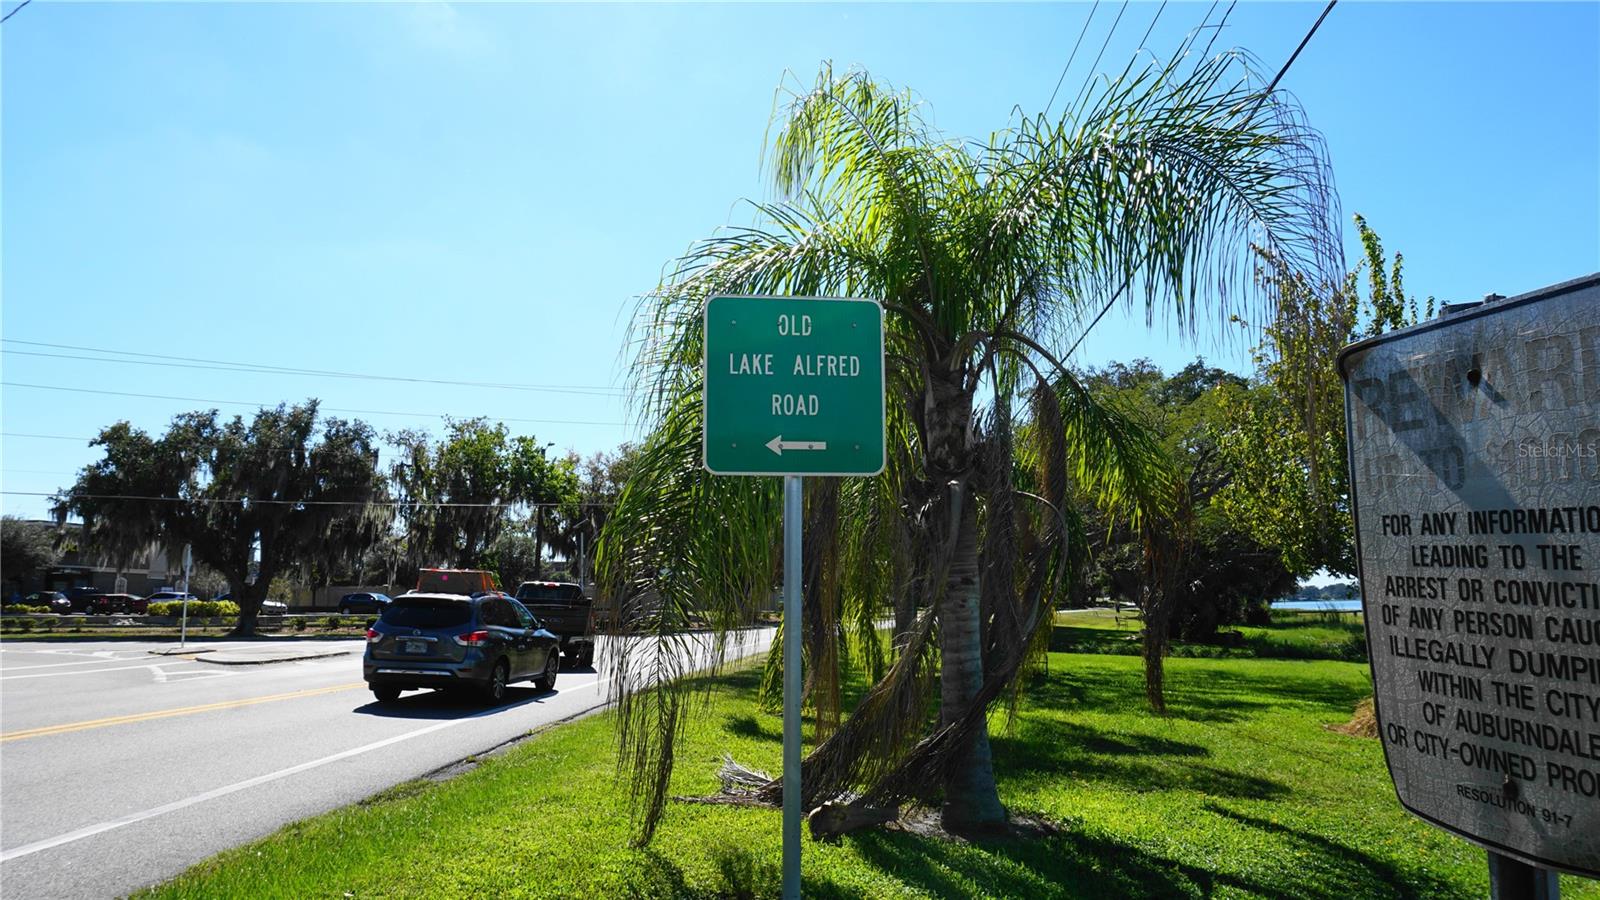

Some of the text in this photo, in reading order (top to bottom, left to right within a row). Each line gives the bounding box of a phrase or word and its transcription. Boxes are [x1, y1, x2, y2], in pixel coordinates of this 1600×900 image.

[778, 314, 812, 336] OLD
[729, 353, 860, 377] LAKE ALFRED
[772, 394, 819, 416] ROAD
[1382, 514, 1412, 537] FOR
[1420, 512, 1457, 536] ANY
[1411, 544, 1583, 571] LEADING TO THE
[1385, 575, 1448, 600] ARREST
[1458, 577, 1484, 602] OR
[1381, 604, 1400, 626] OF
[1409, 606, 1443, 630] ANY
[1454, 609, 1534, 639] PERSON
[1389, 635, 1495, 669] ILLEGALLY
[1418, 670, 1600, 723] WITHIN THE CITY
[1423, 701, 1600, 760] OF AUBURNDALE
[1387, 722, 1409, 748] OR
[1414, 730, 1537, 781] CITY-OWNED
[1457, 784, 1573, 829] RESOLUTION 91-7
